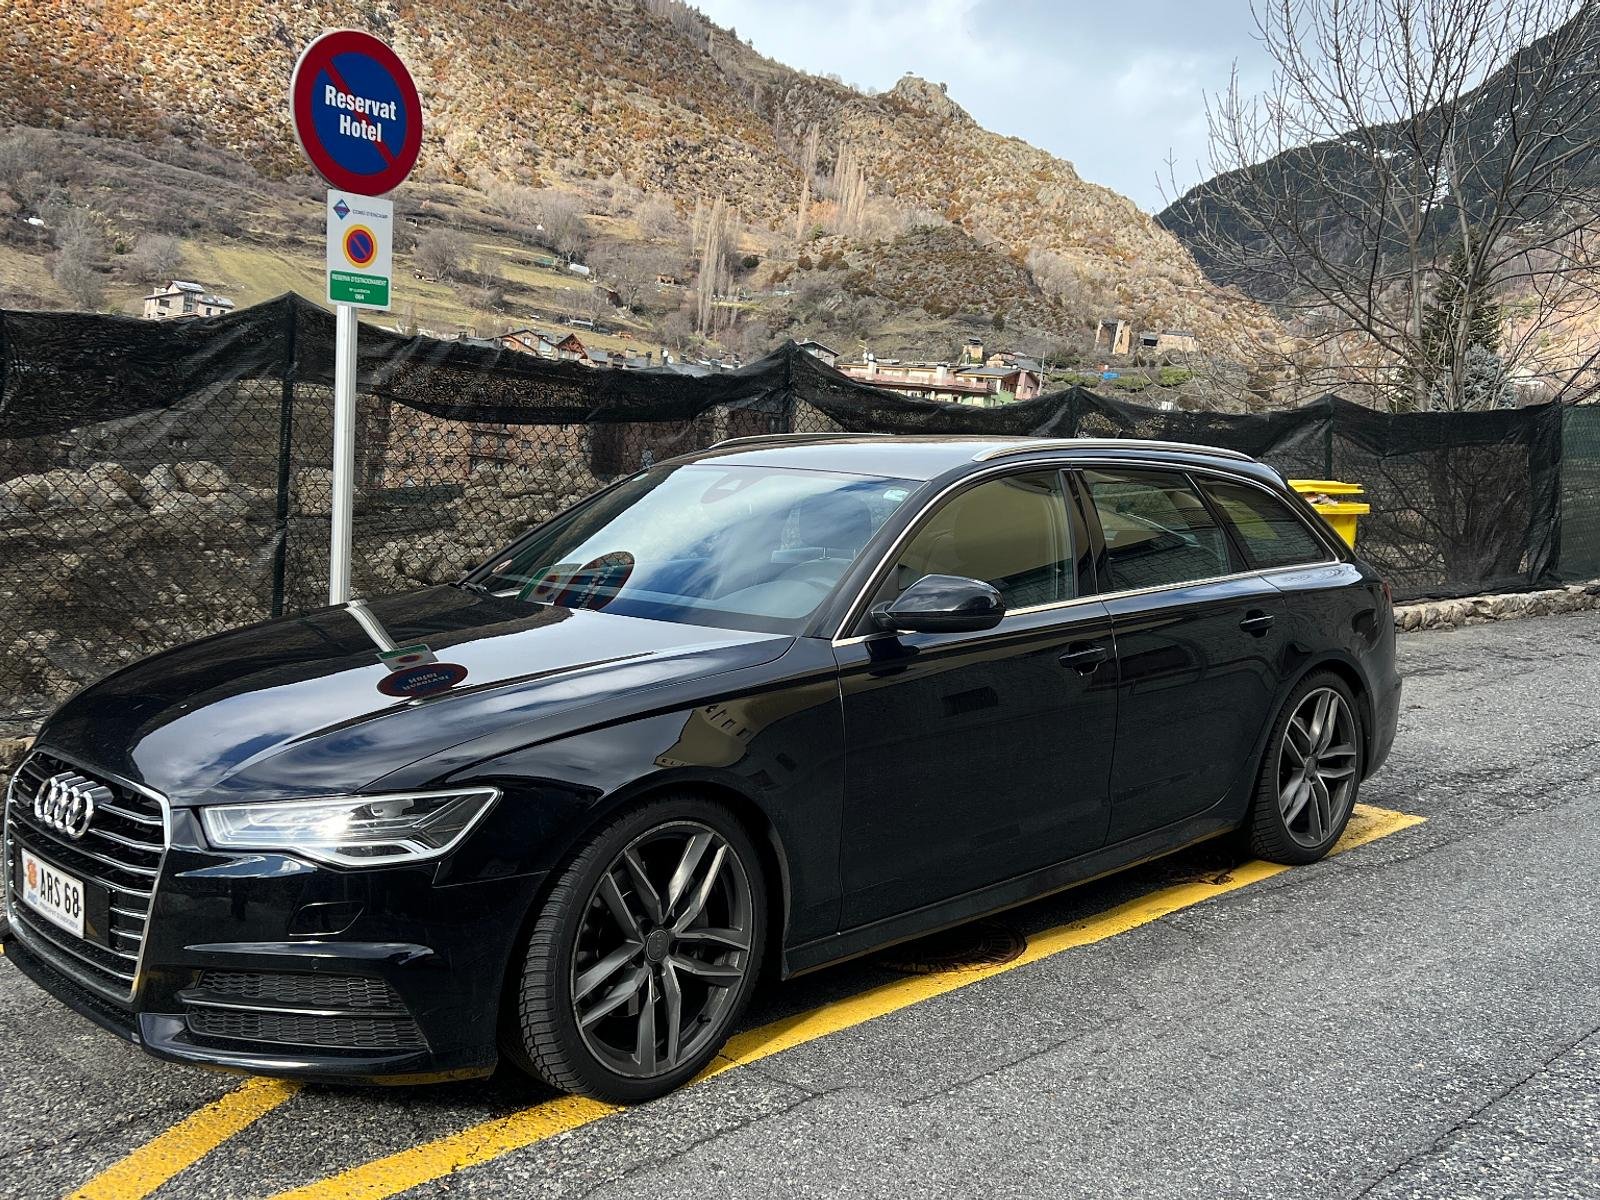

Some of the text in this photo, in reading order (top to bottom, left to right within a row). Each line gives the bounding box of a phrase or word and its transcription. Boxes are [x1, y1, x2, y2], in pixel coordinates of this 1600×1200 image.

[325, 84, 397, 120] Reservat
[339, 114, 382, 143] Hotel
[40, 868, 61, 908] ARS
[65, 882, 79, 919] 68
